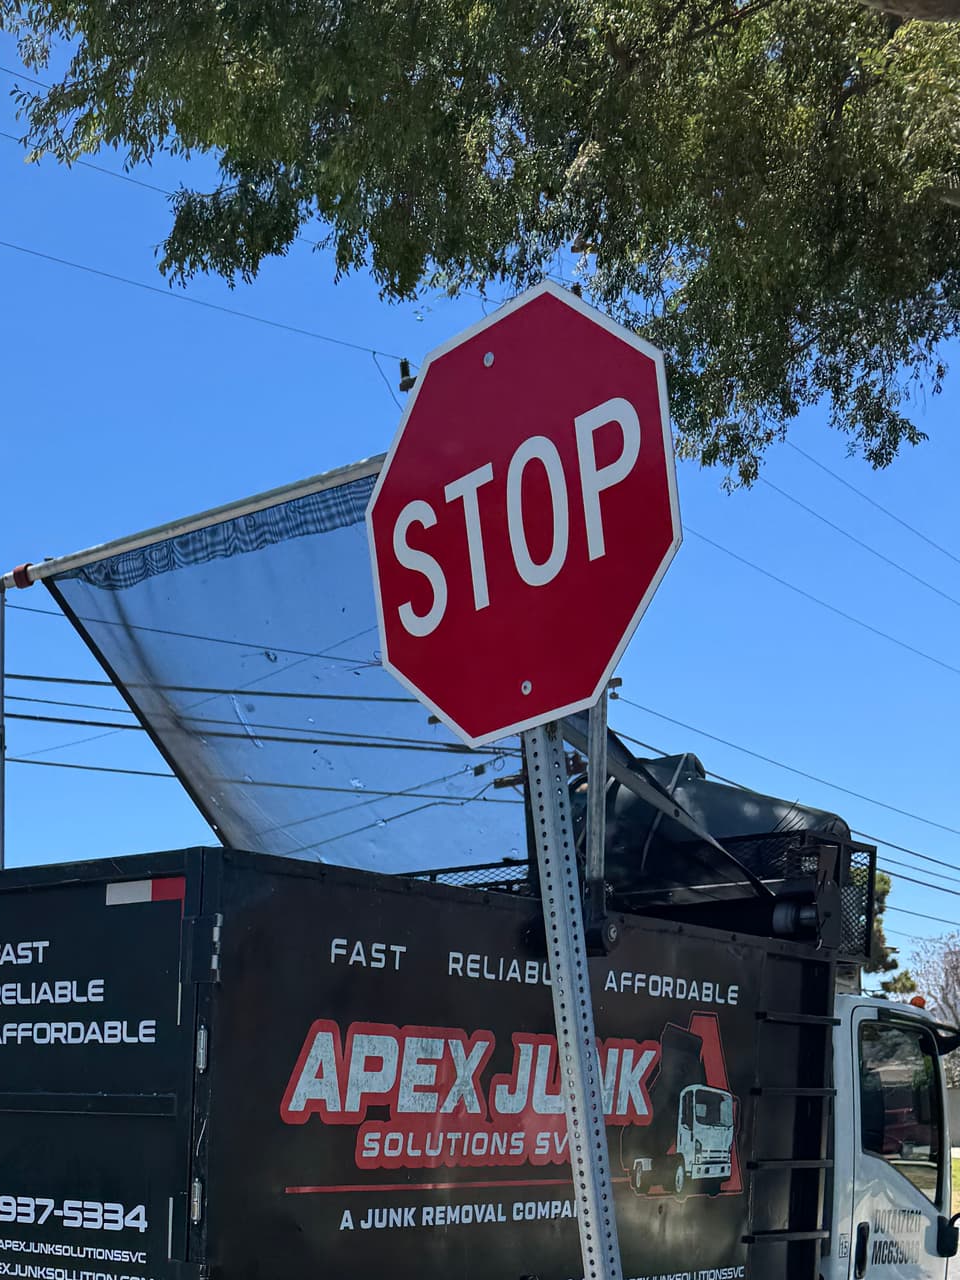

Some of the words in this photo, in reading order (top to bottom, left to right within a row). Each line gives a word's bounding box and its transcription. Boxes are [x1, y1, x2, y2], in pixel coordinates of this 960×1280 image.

[392, 396, 642, 638] STOP
[330, 937, 407, 971] FAST
[447, 951, 554, 986] RELIABL
[604, 969, 740, 1005] AFFORDABLE
[288, 1031, 490, 1115] APEX
[361, 1131, 526, 1158] SOLUTIONS
[533, 1131, 571, 1156] SV
[339, 1210, 354, 1231] A
[360, 1207, 417, 1229] JUNK
[422, 1203, 508, 1226] REMOVAL
